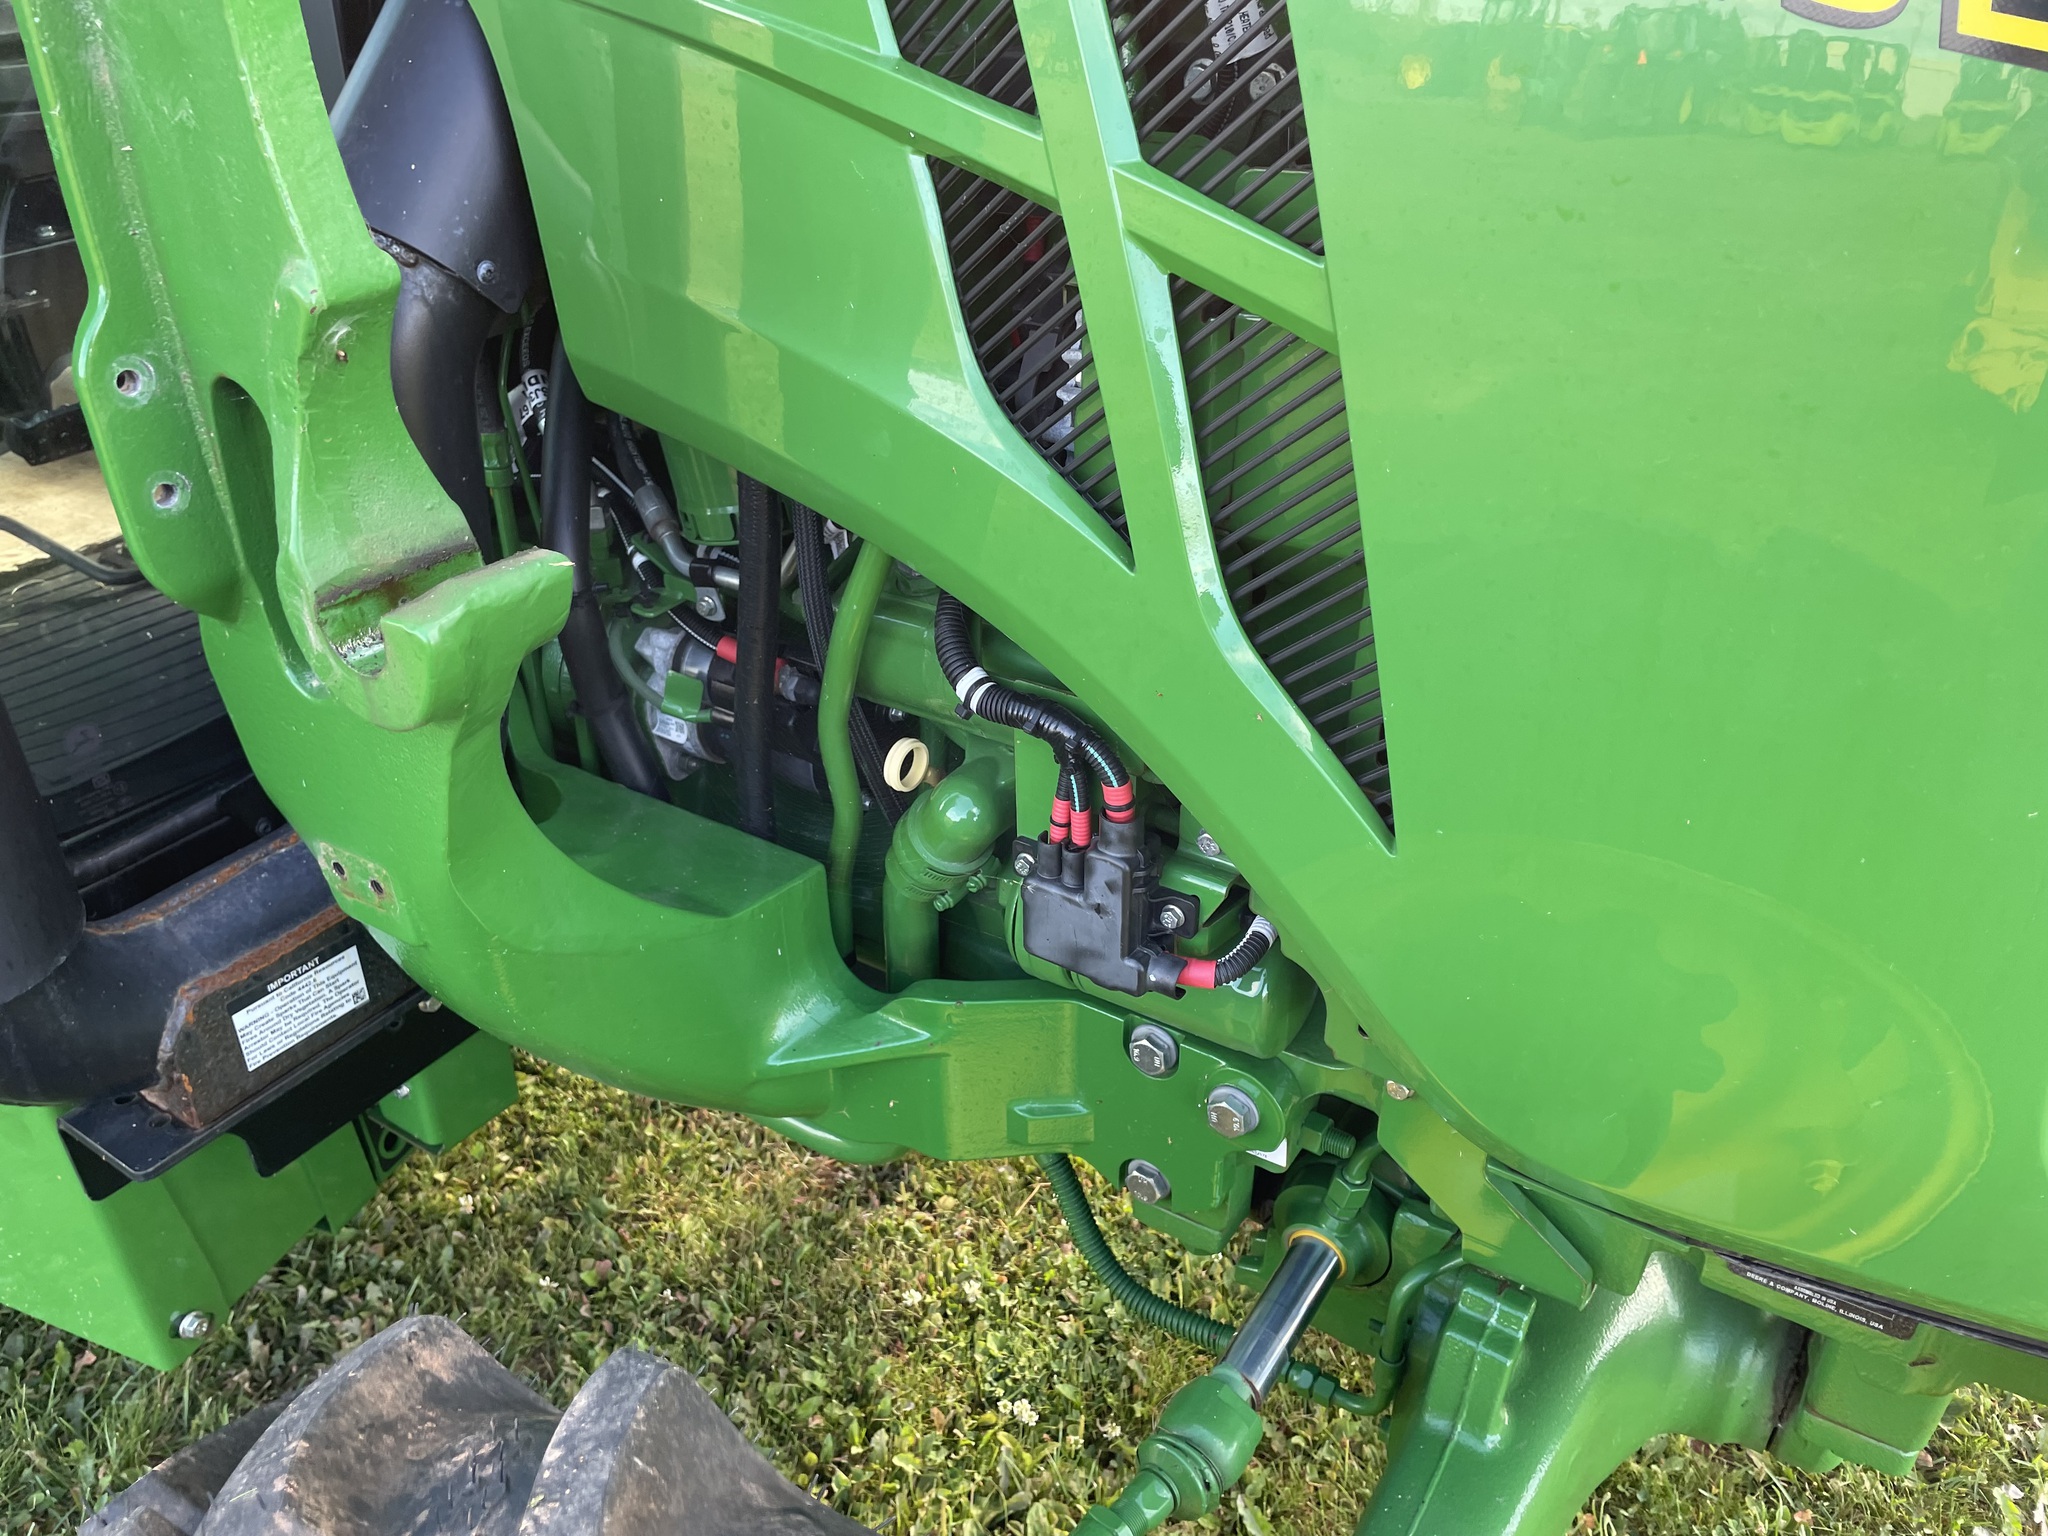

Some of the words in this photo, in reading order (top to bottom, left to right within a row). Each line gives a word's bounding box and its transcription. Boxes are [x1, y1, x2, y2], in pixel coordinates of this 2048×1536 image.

[267, 956, 320, 992] IMPORTANT
[1746, 1271, 1767, 1283] DEERE
[1776, 1283, 1809, 1301] COMPANY,
[1811, 1297, 1836, 1312] MOLINE,
[1838, 1308, 1866, 1325] ILLINOIS,
[1869, 1321, 1883, 1330] USA
